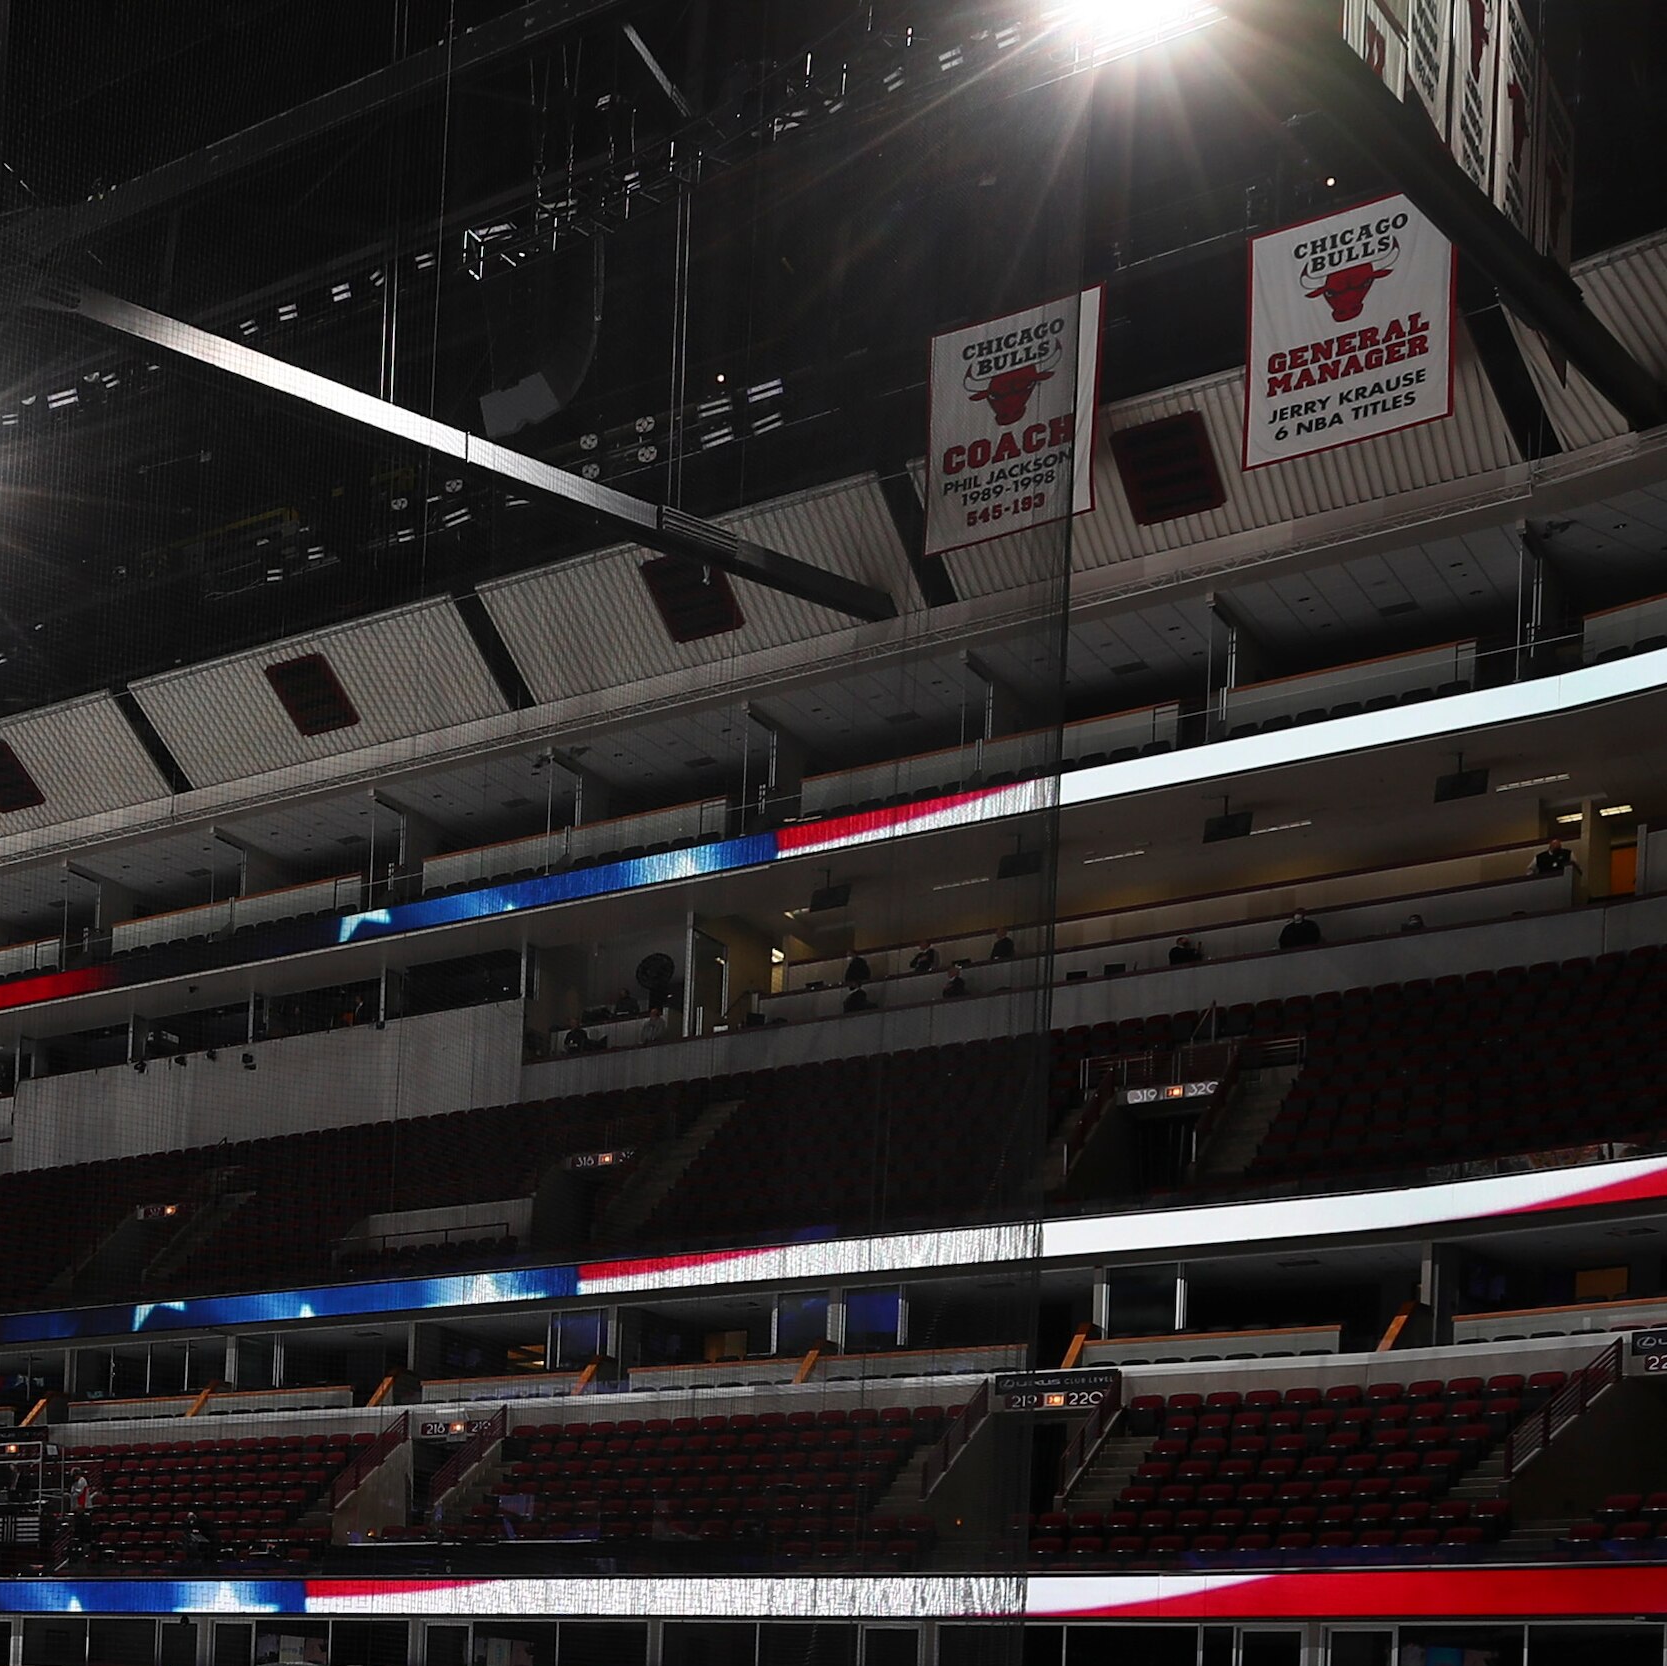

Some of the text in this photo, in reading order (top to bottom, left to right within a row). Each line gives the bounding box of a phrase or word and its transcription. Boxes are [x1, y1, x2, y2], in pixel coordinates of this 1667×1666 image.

[1294, 213, 1408, 262] CHICAGO
[1311, 236, 1392, 274] BULLS
[962, 318, 1065, 362] CHICAGO
[977, 339, 1051, 377] BULLS
[1267, 312, 1431, 375] GENERAL
[1266, 335, 1430, 398] MANAGER
[1268, 367, 1428, 426] JERRY KRAUSE
[1274, 391, 1417, 442] 6 NBA TITLES
[942, 413, 1074, 475] COACH
[943, 450, 1073, 497] PHIL JACKSON
[962, 470, 1056, 507] 1989-1998
[965, 493, 1046, 527] 545-193
[1134, 1089, 1158, 1102] 319
[1068, 1391, 1104, 1406] 220
